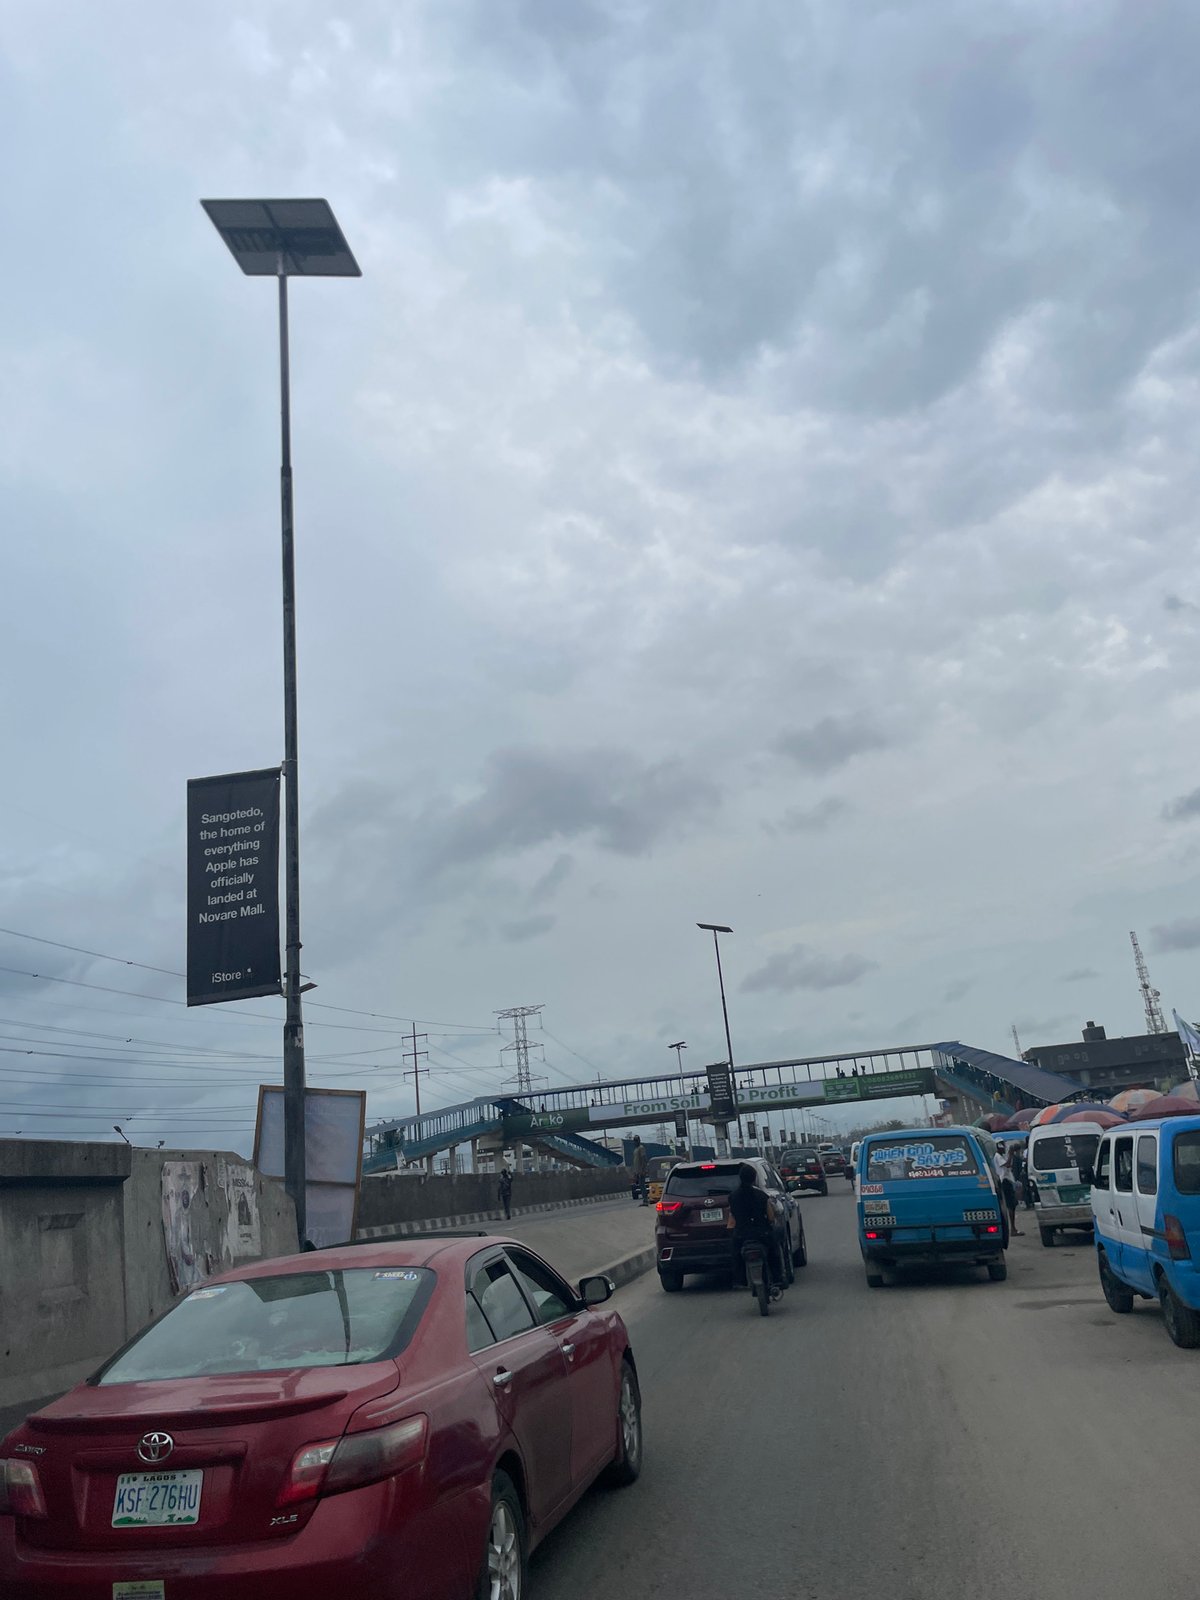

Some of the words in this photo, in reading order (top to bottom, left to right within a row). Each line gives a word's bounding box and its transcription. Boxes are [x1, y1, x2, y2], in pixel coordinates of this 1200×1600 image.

[201, 807, 264, 824] Sangotedo,
[200, 829, 218, 840] the
[220, 825, 251, 838] home
[254, 820, 266, 832] of
[204, 840, 260, 856] everything
[205, 859, 237, 874] Apple
[239, 856, 259, 868] has
[210, 872, 254, 888] officially
[207, 890, 244, 906] landed
[246, 888, 258, 899] at
[198, 910, 238, 924] Novare
[240, 903, 266, 917] Mall.
[211, 971, 242, 984] iStore
[623, 1102, 667, 1116] From
[670, 1096, 700, 1110] Soil
[749, 1086, 799, 1101] Profit
[143, 1474, 177, 1482] LAGOS
[270, 1514, 298, 1526] XLE
